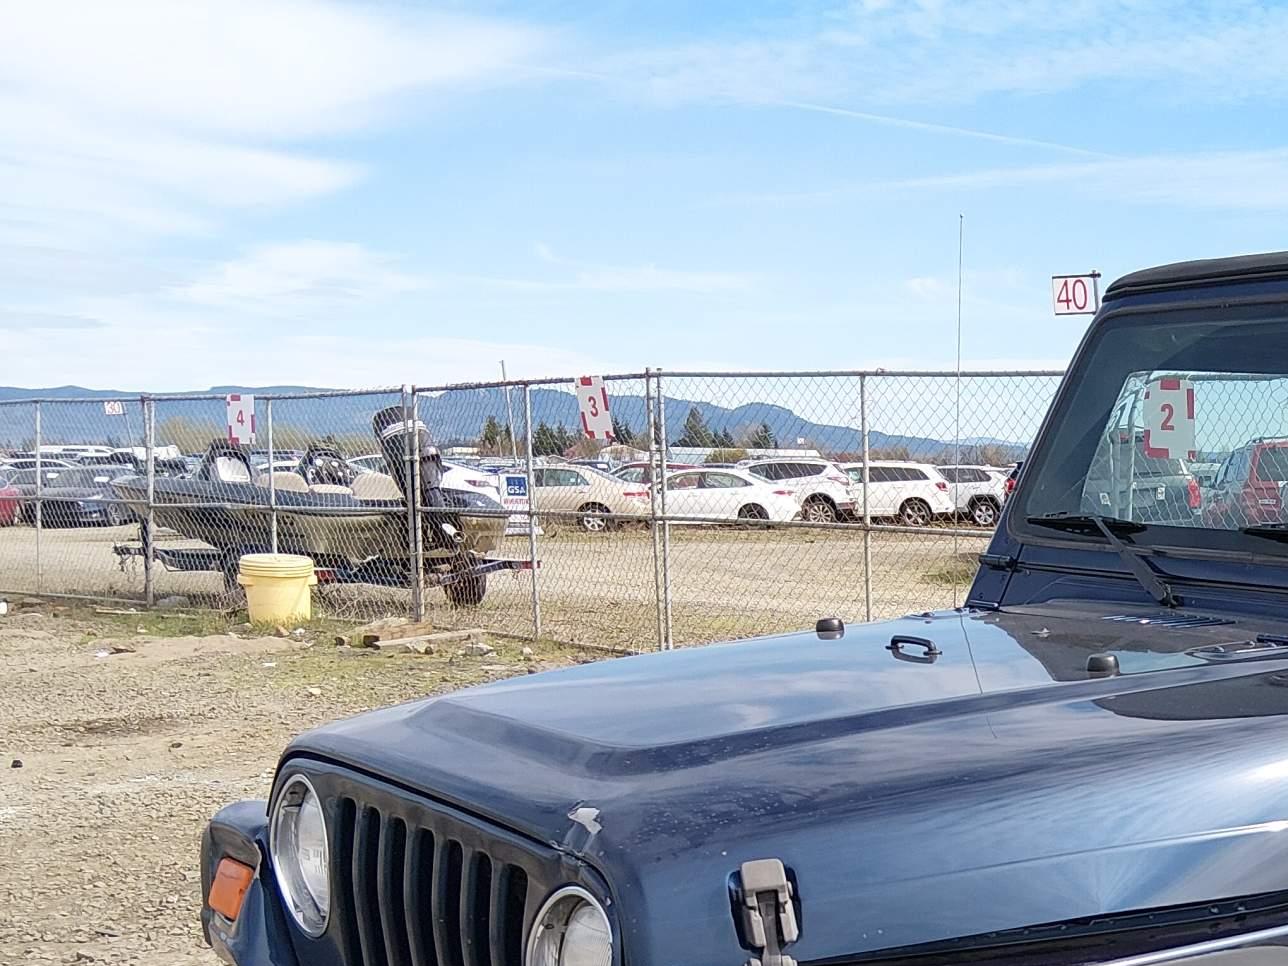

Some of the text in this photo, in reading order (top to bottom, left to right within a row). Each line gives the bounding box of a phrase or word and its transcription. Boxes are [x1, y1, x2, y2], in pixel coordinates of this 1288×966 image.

[1057, 279, 1087, 310] 40
[237, 410, 244, 426] 4
[588, 396, 599, 417] 3
[1161, 404, 1174, 430] 2
